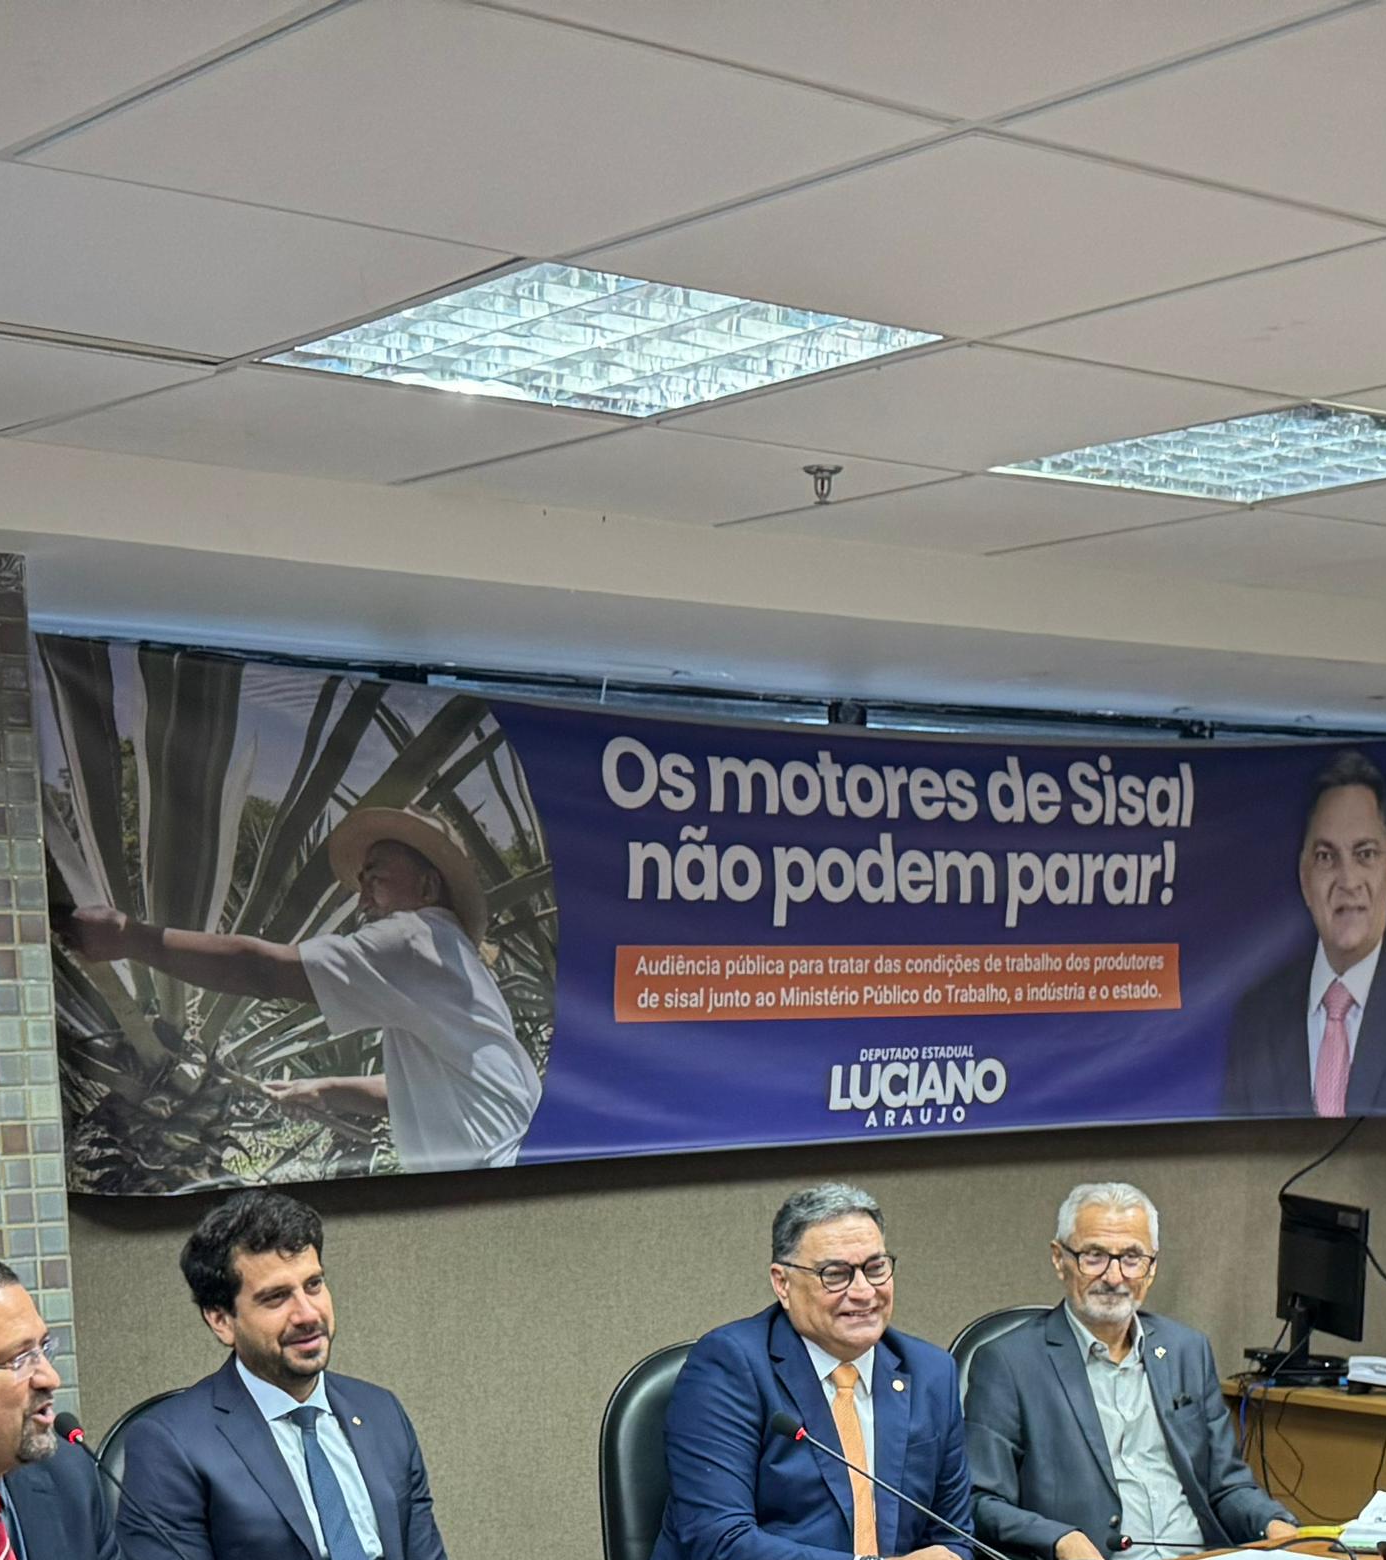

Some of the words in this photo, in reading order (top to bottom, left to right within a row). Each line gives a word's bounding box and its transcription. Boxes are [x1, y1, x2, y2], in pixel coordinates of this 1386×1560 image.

[602, 736, 696, 811] Os
[709, 751, 979, 822] motores
[987, 755, 1062, 824] de
[1068, 754, 1194, 829] Sisal
[627, 825, 763, 901] não
[772, 832, 995, 927] podem
[1005, 840, 1176, 928] parar!
[635, 954, 721, 976] Audiência
[725, 954, 785, 979] pública
[789, 958, 824, 979] para
[828, 956, 870, 975] tratar
[874, 954, 902, 974] das
[905, 953, 981, 977] condições
[984, 953, 1002, 973] de
[1005, 952, 1062, 972] trabalho
[1065, 952, 1090, 972] dos
[1093, 951, 1164, 975] produtores
[637, 987, 660, 1008] de
[664, 987, 704, 1008] sisal
[707, 987, 751, 1013] junto
[755, 991, 776, 1007] ao
[780, 985, 859, 1007] Ministério
[863, 984, 918, 1005] Público
[923, 984, 942, 1004] do
[945, 983, 1011, 1005] Trabalho,
[1015, 986, 1023, 1001] a
[1026, 982, 1085, 1001] indústria
[1088, 984, 1097, 1000] e
[1100, 984, 1109, 1000] o
[1112, 980, 1162, 1000] estado.
[860, 1047, 918, 1062] DEPUTADO
[922, 1045, 974, 1059] ESTADUAL
[828, 1058, 1006, 1111] LUCIANO
[865, 1106, 965, 1128] ARAUJO
